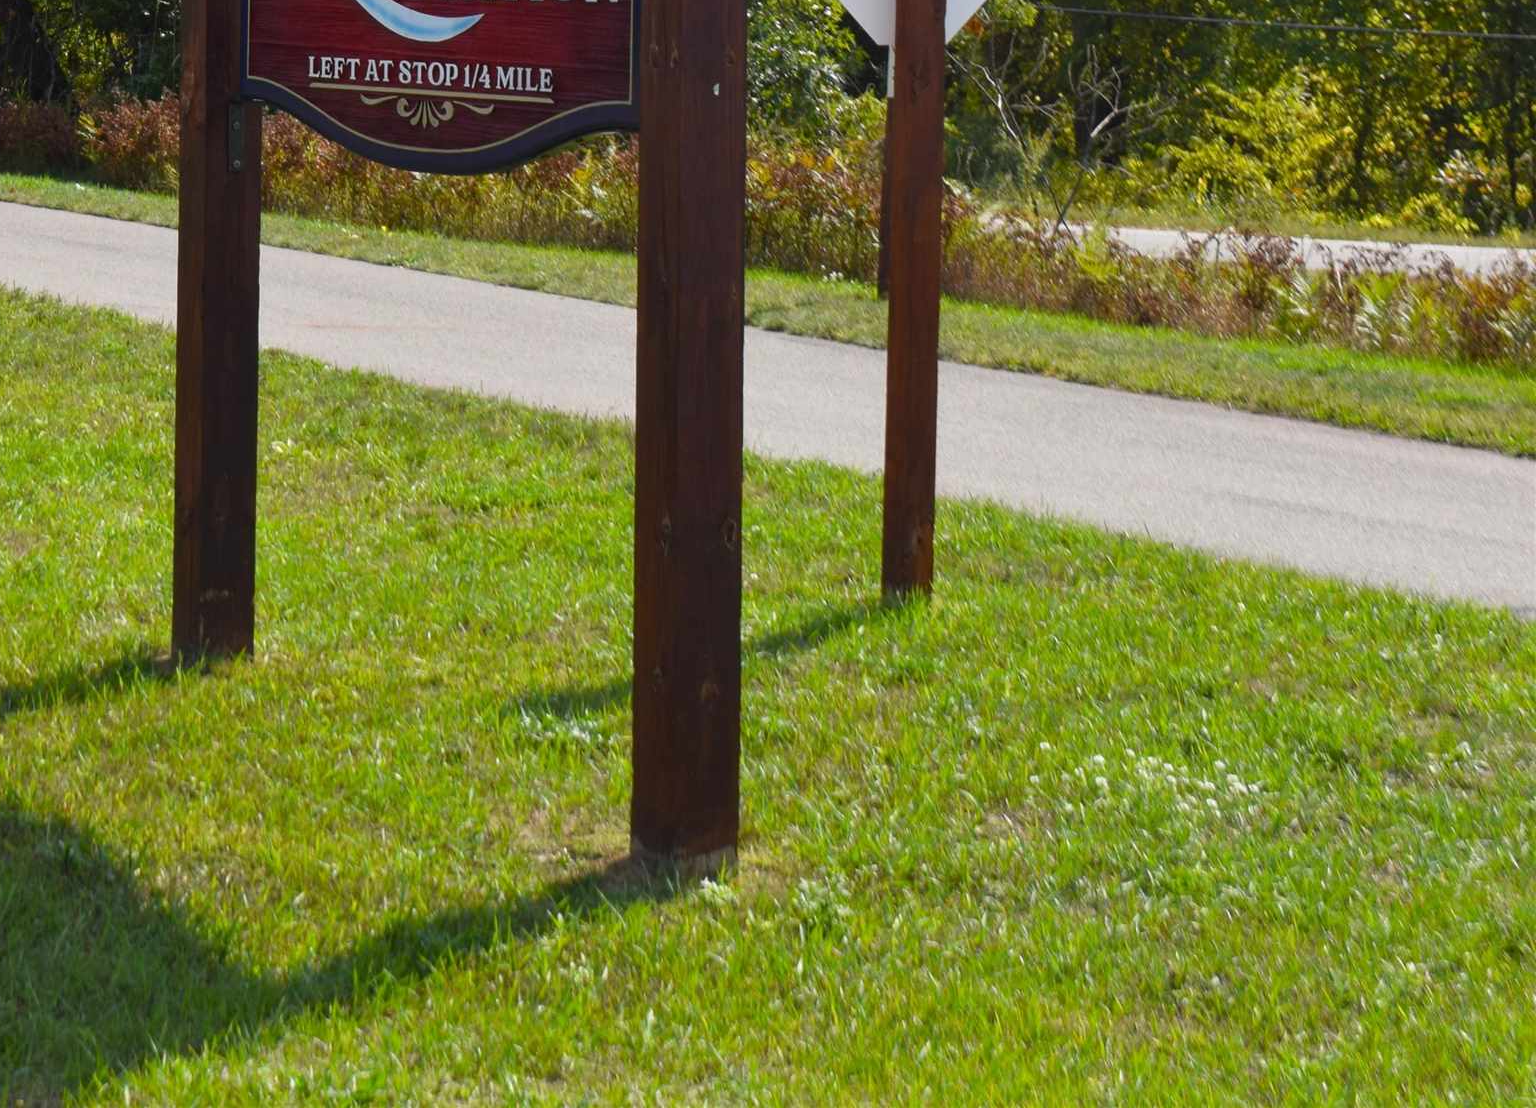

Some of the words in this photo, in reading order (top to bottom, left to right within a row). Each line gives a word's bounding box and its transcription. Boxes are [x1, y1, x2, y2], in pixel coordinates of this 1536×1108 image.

[308, 56, 360, 80] LEFT
[364, 58, 393, 82] AT
[398, 61, 459, 87] STOP
[464, 64, 492, 90] 1/4
[496, 66, 554, 93] MILE
